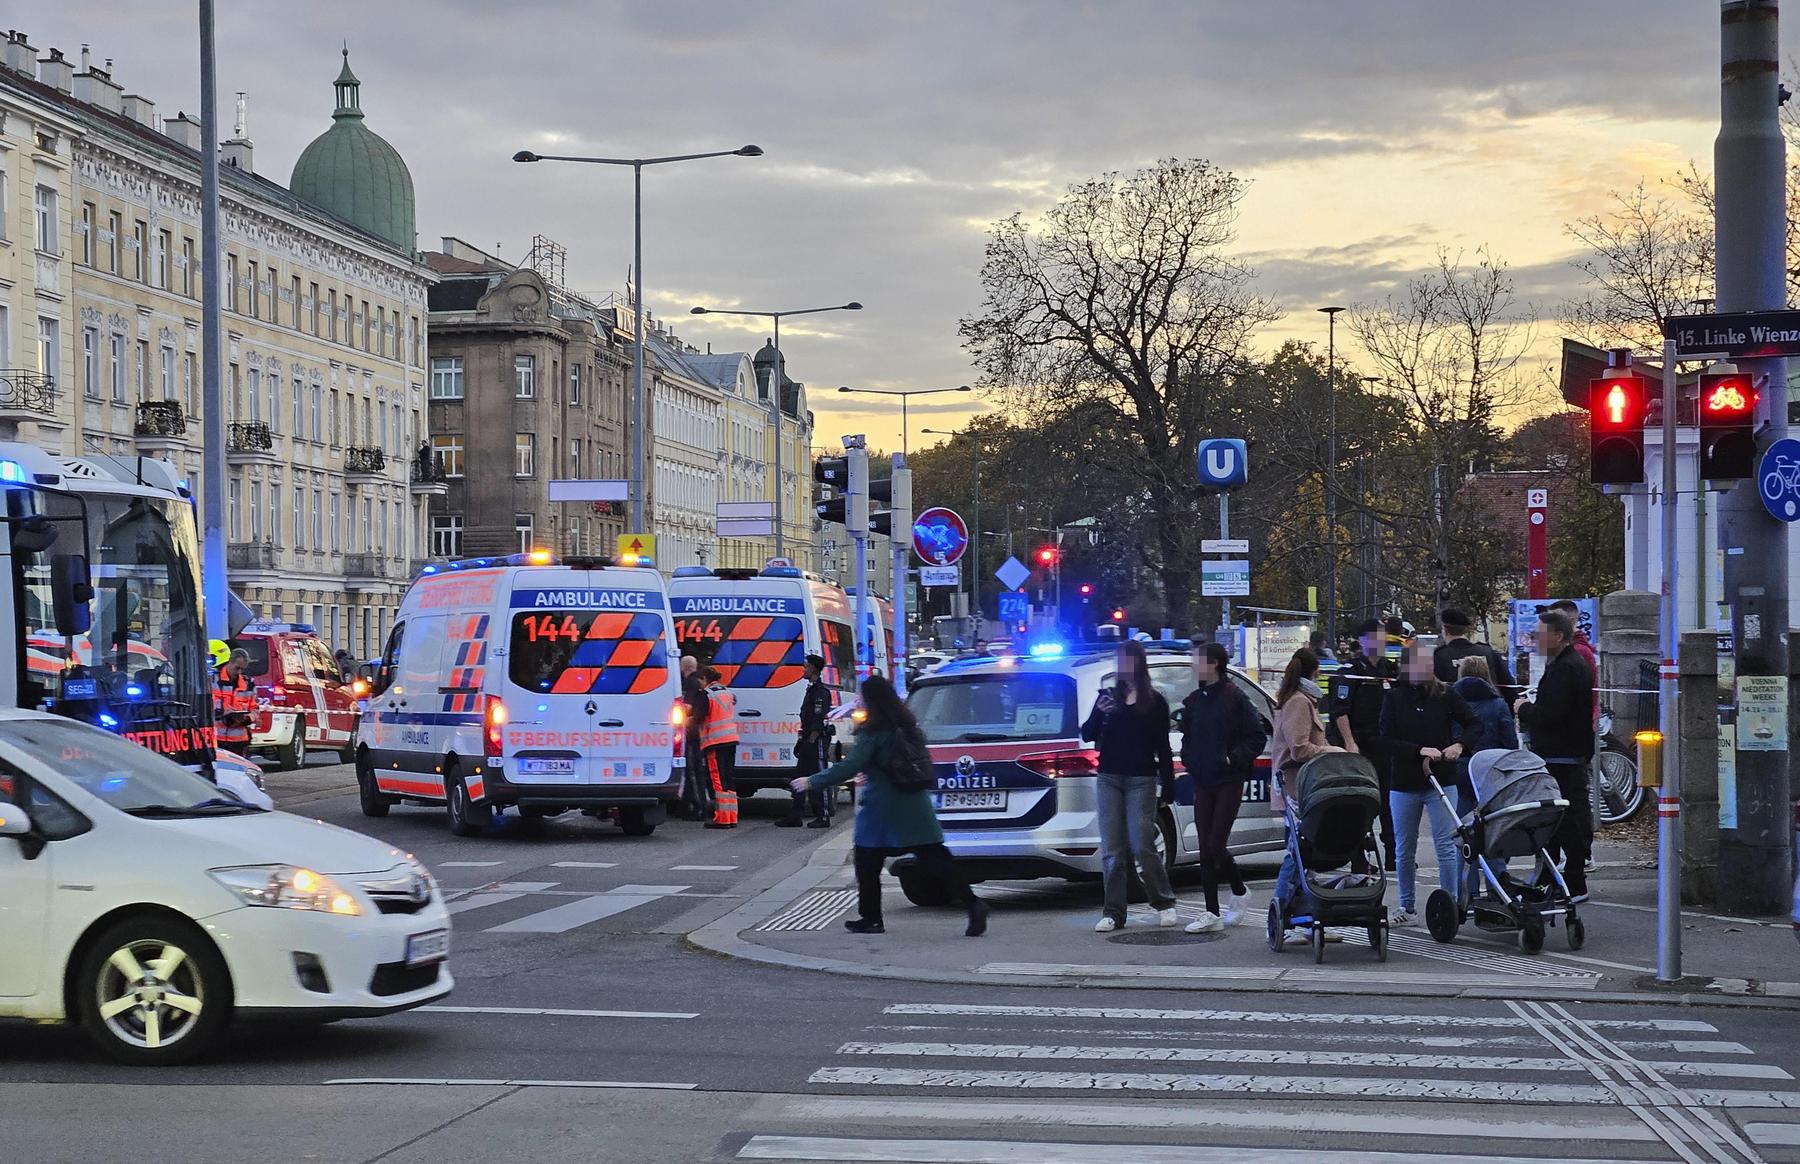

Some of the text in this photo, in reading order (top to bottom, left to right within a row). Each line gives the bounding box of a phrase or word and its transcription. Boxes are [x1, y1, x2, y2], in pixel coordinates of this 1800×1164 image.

[1704, 328, 1746, 345] Linke
[1207, 449, 1234, 479] U
[535, 591, 646, 607] AMBULANCE
[685, 598, 786, 612] AMBULANCE
[523, 615, 580, 642] 144
[675, 619, 723, 643] 144
[401, 730, 429, 745] AMBULANCE
[523, 731, 669, 747] BERUFSRETTUNG
[937, 776, 996, 789] POLIZEI
